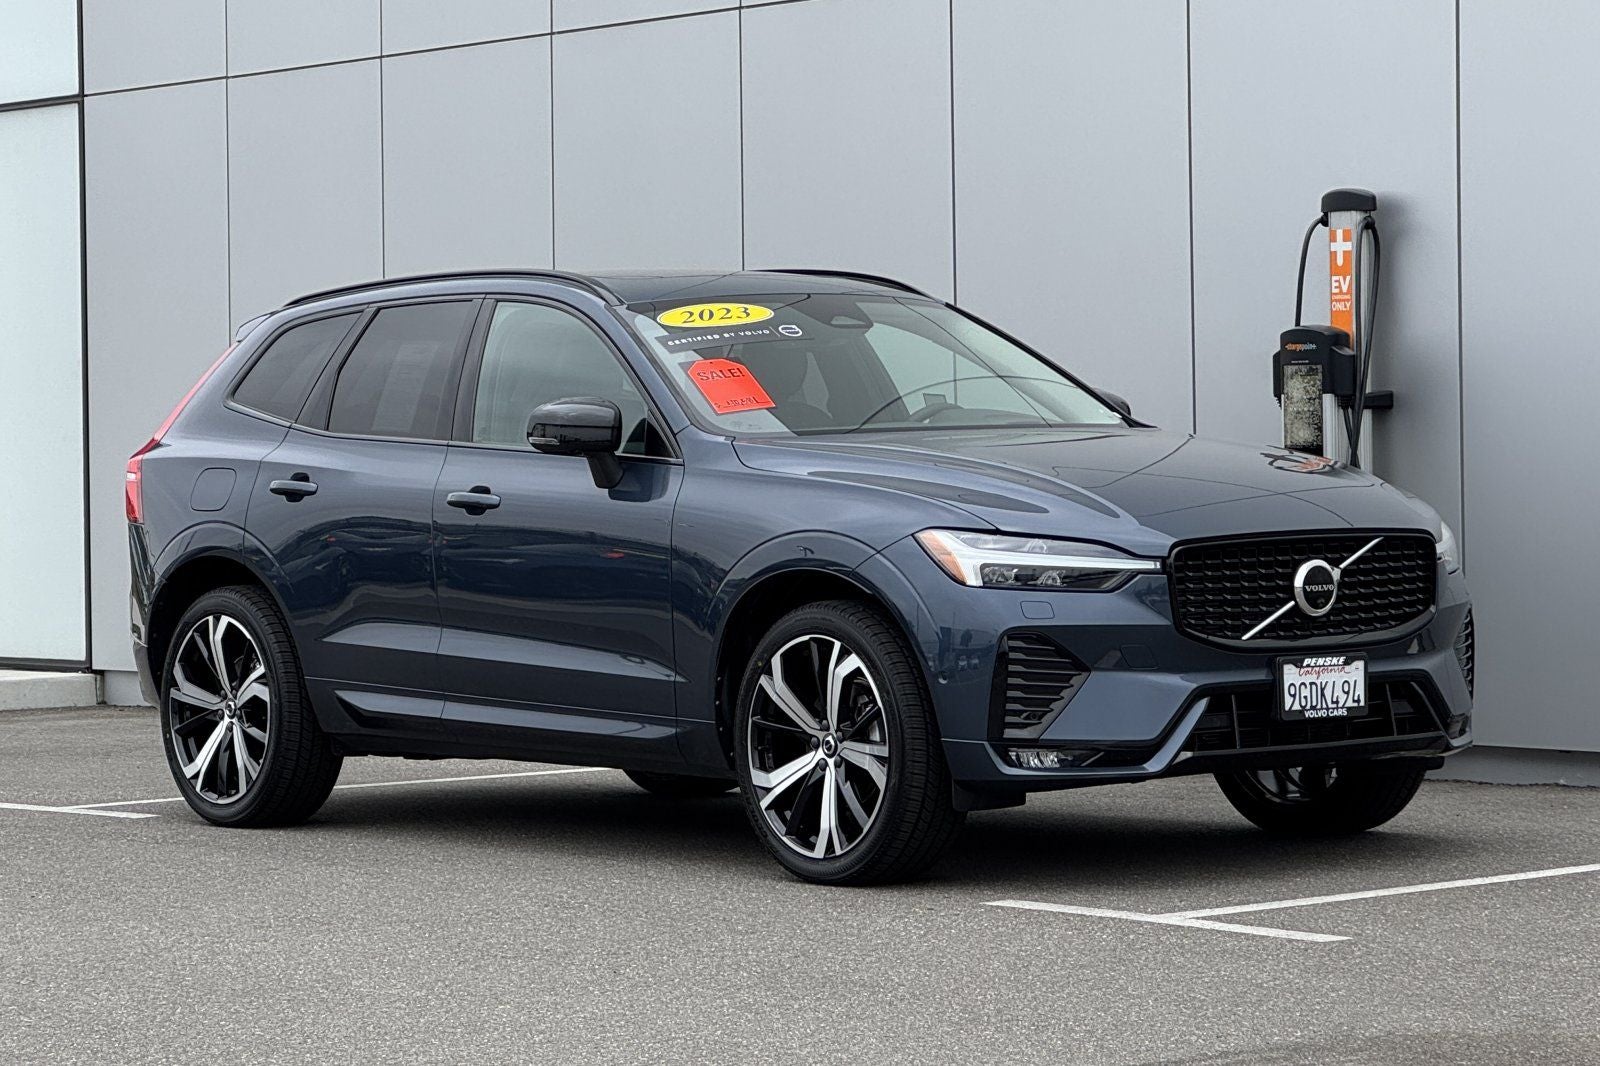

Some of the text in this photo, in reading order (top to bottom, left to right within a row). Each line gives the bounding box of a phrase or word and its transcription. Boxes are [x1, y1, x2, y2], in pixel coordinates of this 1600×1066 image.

[1331, 275, 1351, 293] EV
[1331, 301, 1351, 311] ONLY
[680, 306, 751, 324] 2023
[667, 334, 720, 346] CERTIFIED
[697, 367, 746, 381] SALE!
[1304, 584, 1335, 592] VOLVO
[1302, 656, 1347, 667] PENSKE
[1298, 666, 1351, 679] California
[1287, 679, 1361, 711] 9GDK494
[1304, 708, 1348, 718] VOLVO CARS
